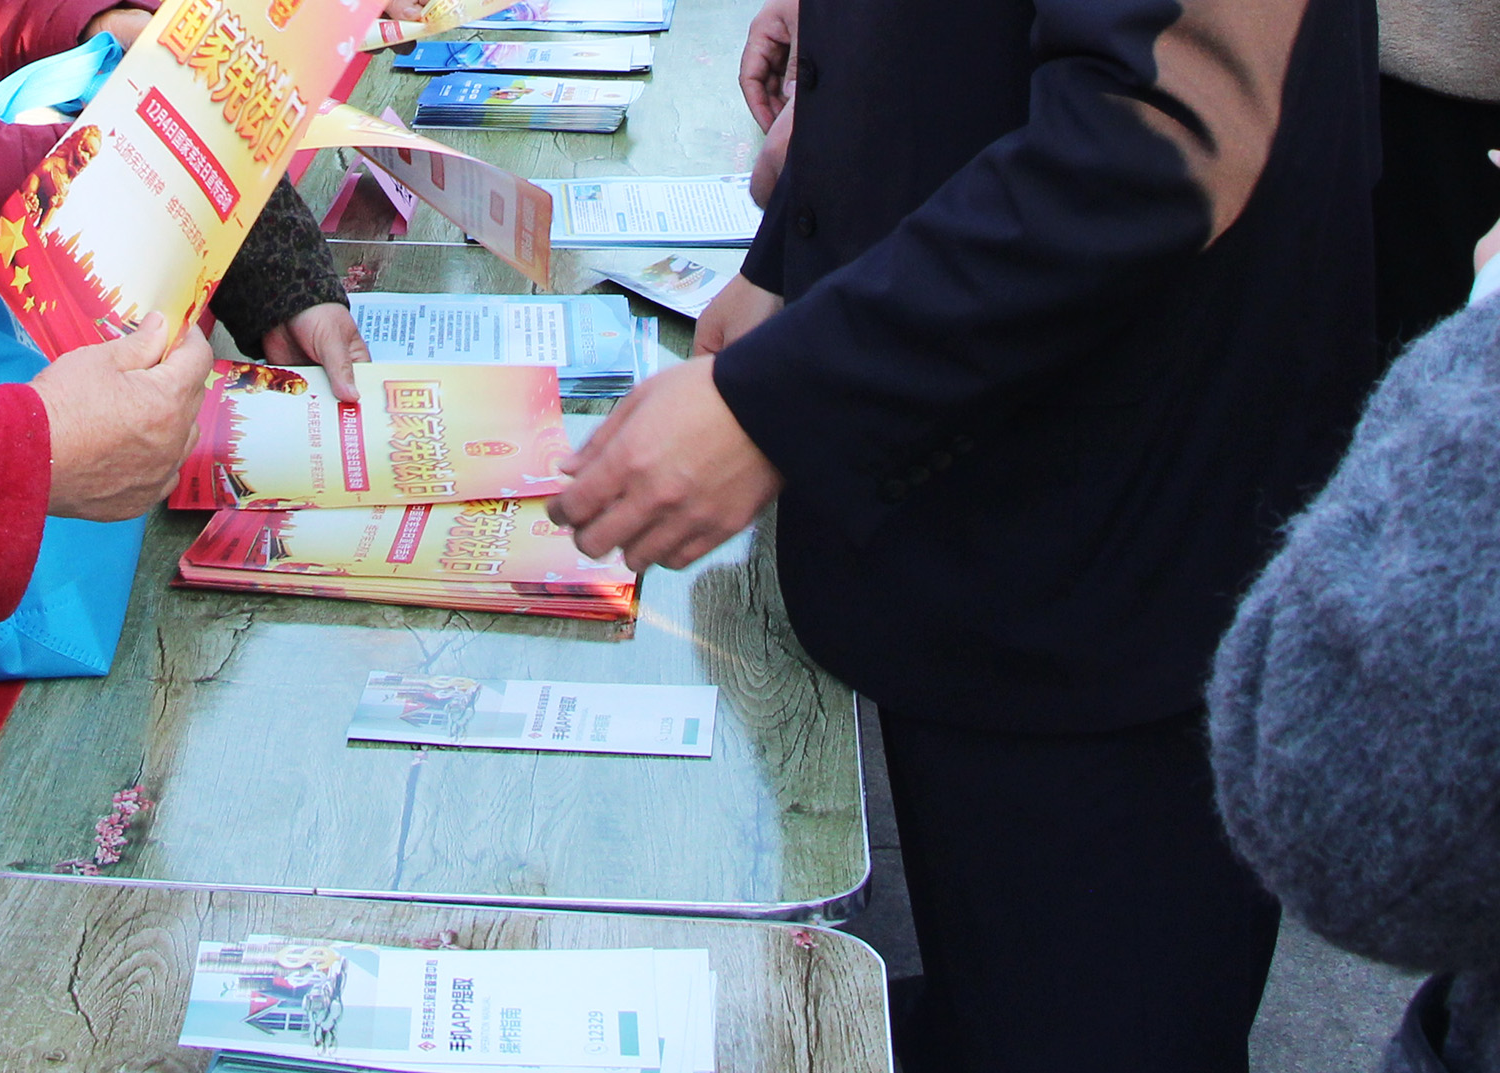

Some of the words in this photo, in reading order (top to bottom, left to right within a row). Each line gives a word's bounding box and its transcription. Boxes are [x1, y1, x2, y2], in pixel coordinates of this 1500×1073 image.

[114, 133, 166, 196] 弘扬宪法精神
[145, 97, 235, 214] 12月4日国家宪法日宣传活动
[384, 378, 460, 498] 国家宪法日
[552, 695, 578, 742] 手机APP提取
[448, 977, 475, 1053] 手机APP提取
[499, 1007, 523, 1054] 操作指南
[587, 1010, 604, 1043] 12329
